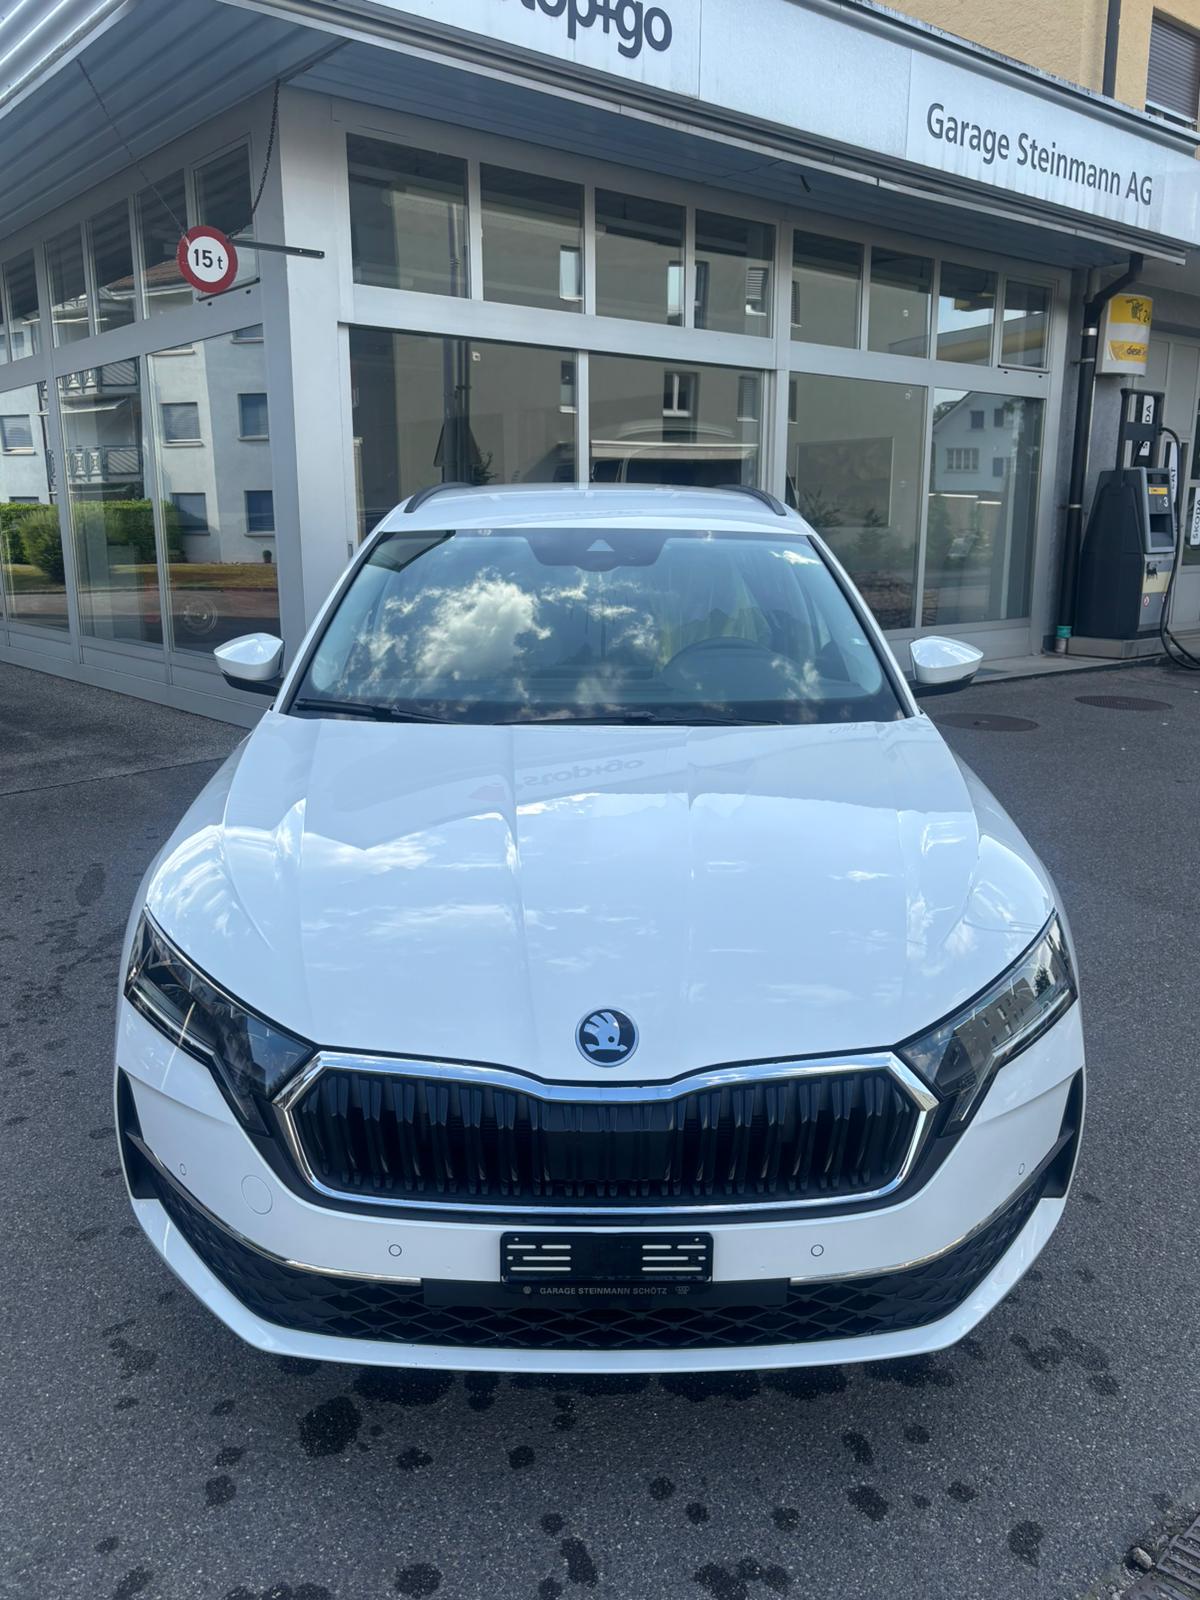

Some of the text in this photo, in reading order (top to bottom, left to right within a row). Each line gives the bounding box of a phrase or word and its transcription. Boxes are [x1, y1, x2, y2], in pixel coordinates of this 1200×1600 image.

[505, 0, 672, 58] p+go
[926, 102, 1153, 206] Garage Steinmann AG
[193, 248, 223, 270] 15 t
[1163, 496, 1169, 508] 3
[539, 1287, 576, 1295] GARAGE
[578, 1287, 631, 1295] STEINMANN
[632, 1285, 668, 1295] SCHÖTZ
